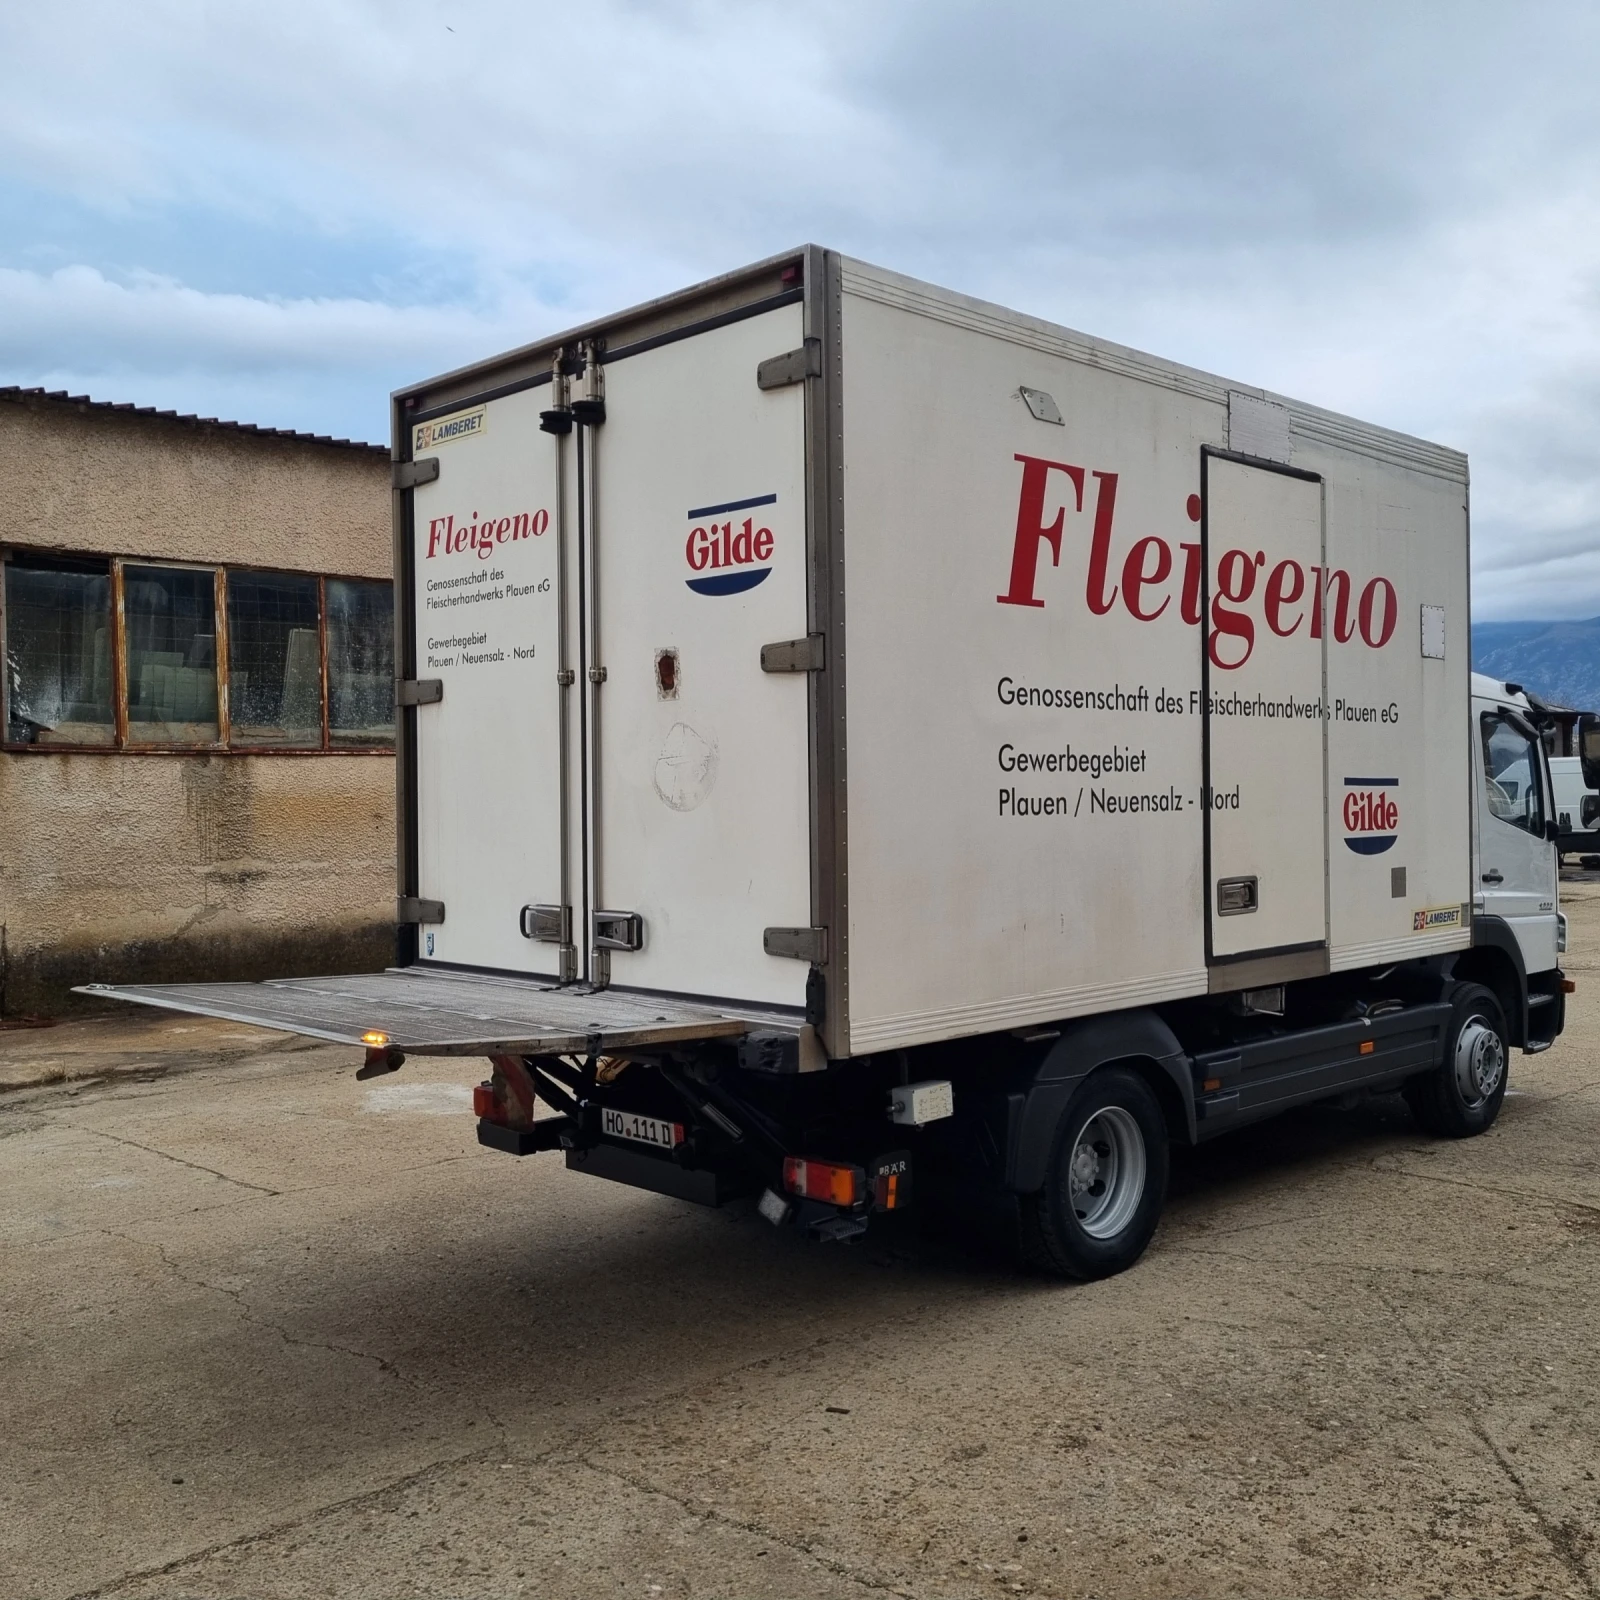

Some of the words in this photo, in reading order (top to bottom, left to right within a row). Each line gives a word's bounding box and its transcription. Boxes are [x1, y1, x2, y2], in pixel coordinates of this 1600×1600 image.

[432, 414, 483, 441] LAMBERET
[425, 508, 549, 560] Fleigeno
[685, 517, 774, 571] Gilde
[996, 453, 1398, 670] Fleigeno
[426, 569, 488, 592] Genossenschaft
[490, 567, 504, 581] des
[426, 586, 504, 610] Fleischerhandwerks
[506, 584, 534, 598] Plauen
[537, 578, 550, 592] eG
[427, 632, 487, 650] Gewerbegebiet
[427, 655, 454, 668] Plauen
[462, 648, 504, 665] Neuensalz
[513, 644, 535, 660] Nord
[997, 676, 1150, 712] Genossenschaft
[1155, 687, 1184, 714] des
[1335, 699, 1377, 723] Plauen
[1380, 702, 1399, 724] eG
[998, 743, 1147, 779] Gewerbegebiet
[999, 787, 1068, 816] Plauen
[1090, 785, 1183, 814] Neuensalz
[1343, 791, 1398, 832] Gilde
[1425, 910, 1460, 925] LAMBERET
[606, 1110, 624, 1135] HO
[632, 1117, 658, 1143] 111
[661, 1124, 671, 1145] D
